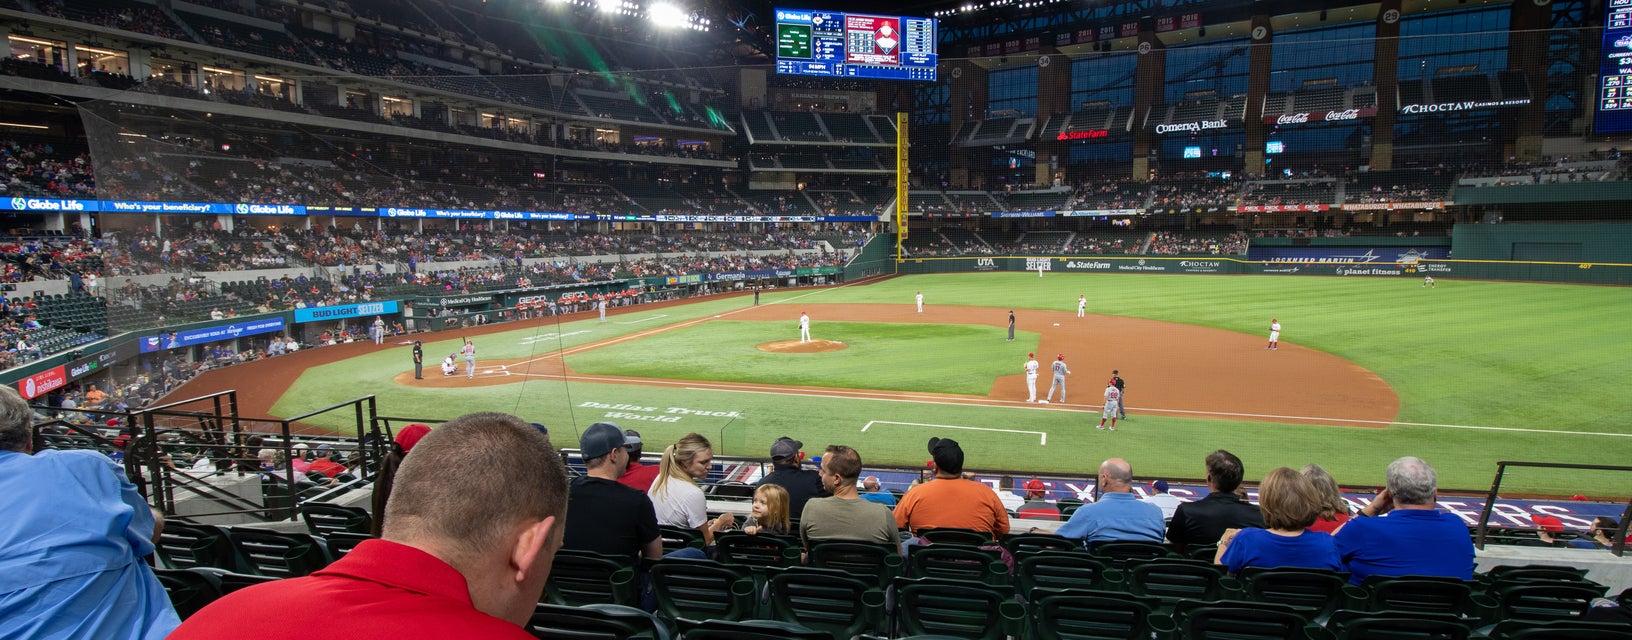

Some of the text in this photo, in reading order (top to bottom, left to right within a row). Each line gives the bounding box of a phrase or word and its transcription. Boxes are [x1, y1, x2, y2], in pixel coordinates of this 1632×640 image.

[1385, 11, 1397, 21] 29
[1256, 28, 1263, 37] 7
[1140, 44, 1150, 52] 26
[1040, 57, 1049, 66] 34
[1409, 102, 1475, 113] CHOCTAW
[1202, 118, 1228, 129] Bank
[28, 200, 83, 210] Globe Life
[143, 204, 162, 212] your
[163, 204, 211, 212] beneficiary?
[1392, 201, 1442, 209] WHATABURGER
[250, 206, 294, 214] Globe Life
[977, 258, 994, 266] UTA
[716, 272, 746, 280] Germania
[1344, 268, 1372, 276] planet
[519, 295, 546, 304] GEICO
[562, 291, 586, 300] GEICO
[333, 307, 358, 316] LIGHT
[358, 303, 384, 314] SELTZER
[71, 367, 83, 377] Globe
[82, 363, 90, 372] Life
[577, 402, 744, 418] Dallas Truck
[604, 412, 682, 423] World
